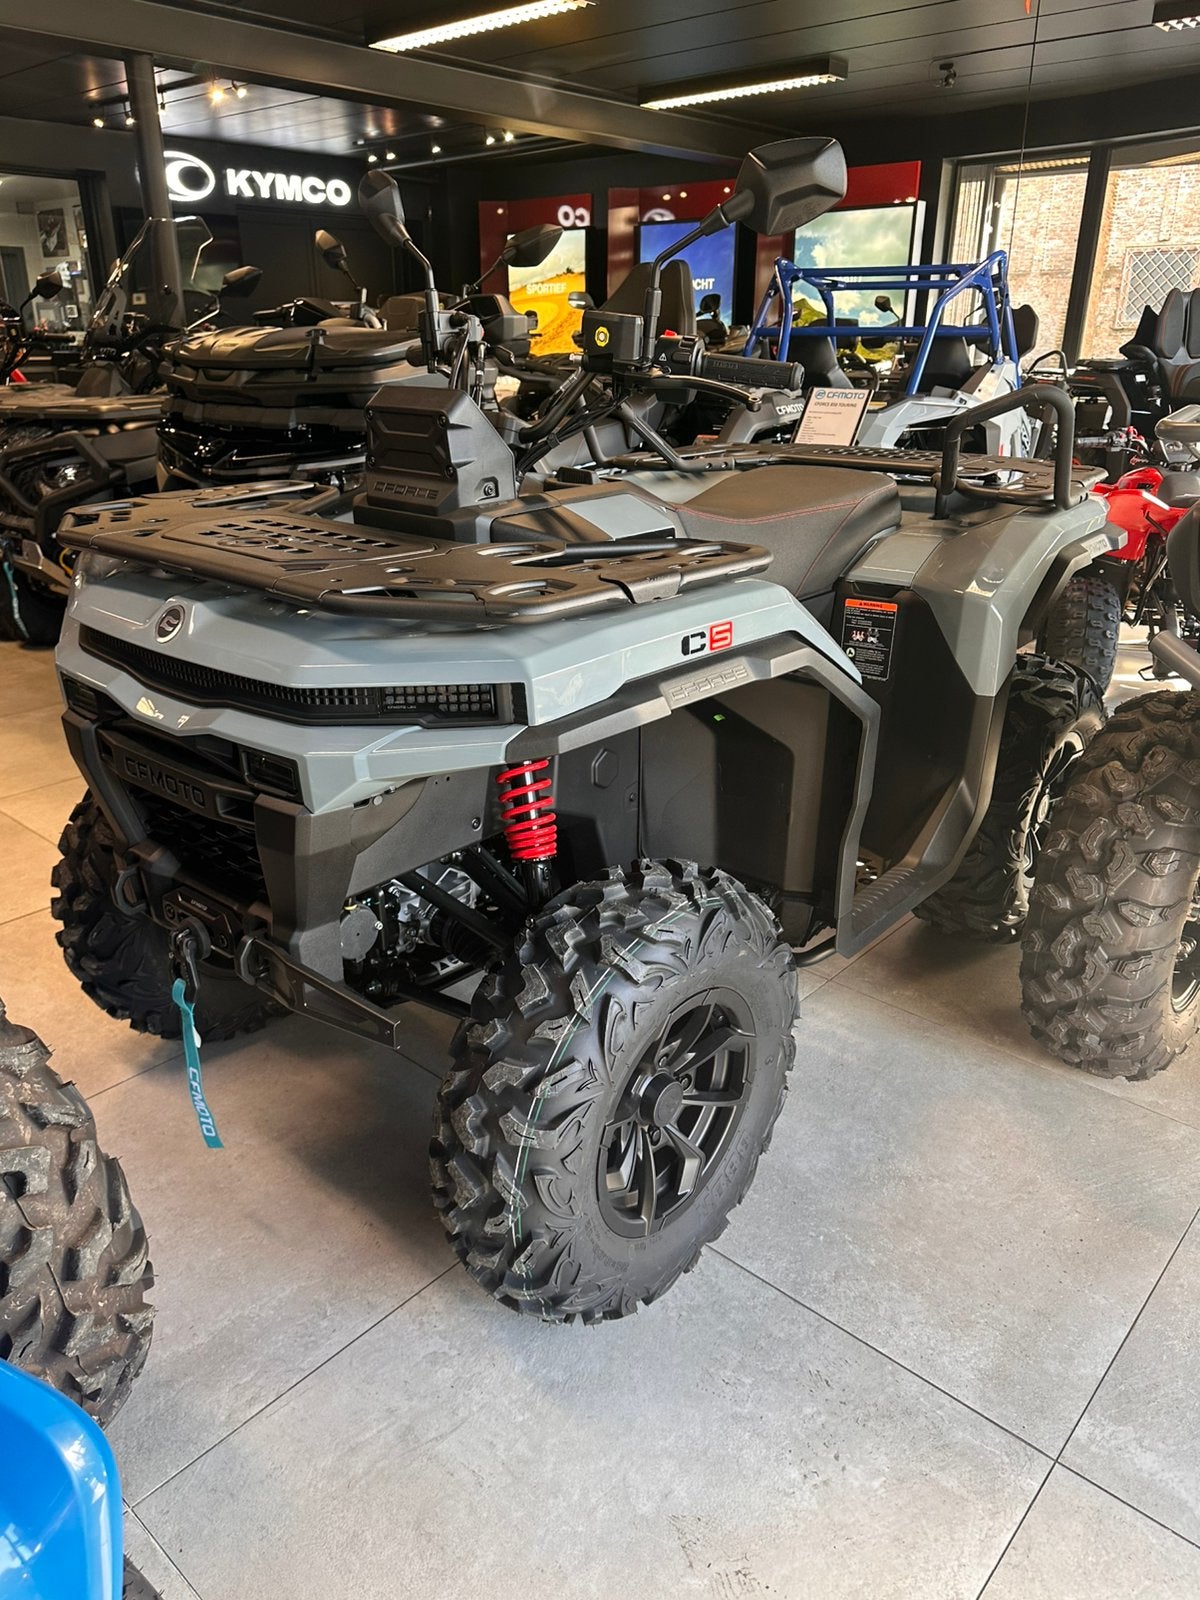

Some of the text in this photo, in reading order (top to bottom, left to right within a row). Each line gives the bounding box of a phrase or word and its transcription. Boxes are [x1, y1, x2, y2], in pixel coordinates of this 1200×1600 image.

[226, 168, 351, 206] KYMCO
[526, 282, 567, 295] SPORTIEF
[826, 391, 866, 400] CFMOTO
[374, 481, 439, 500] CFORCE
[671, 664, 749, 700] CFORCE
[124, 757, 206, 808] CFMOTO
[189, 1066, 216, 1137] CFMOTO
